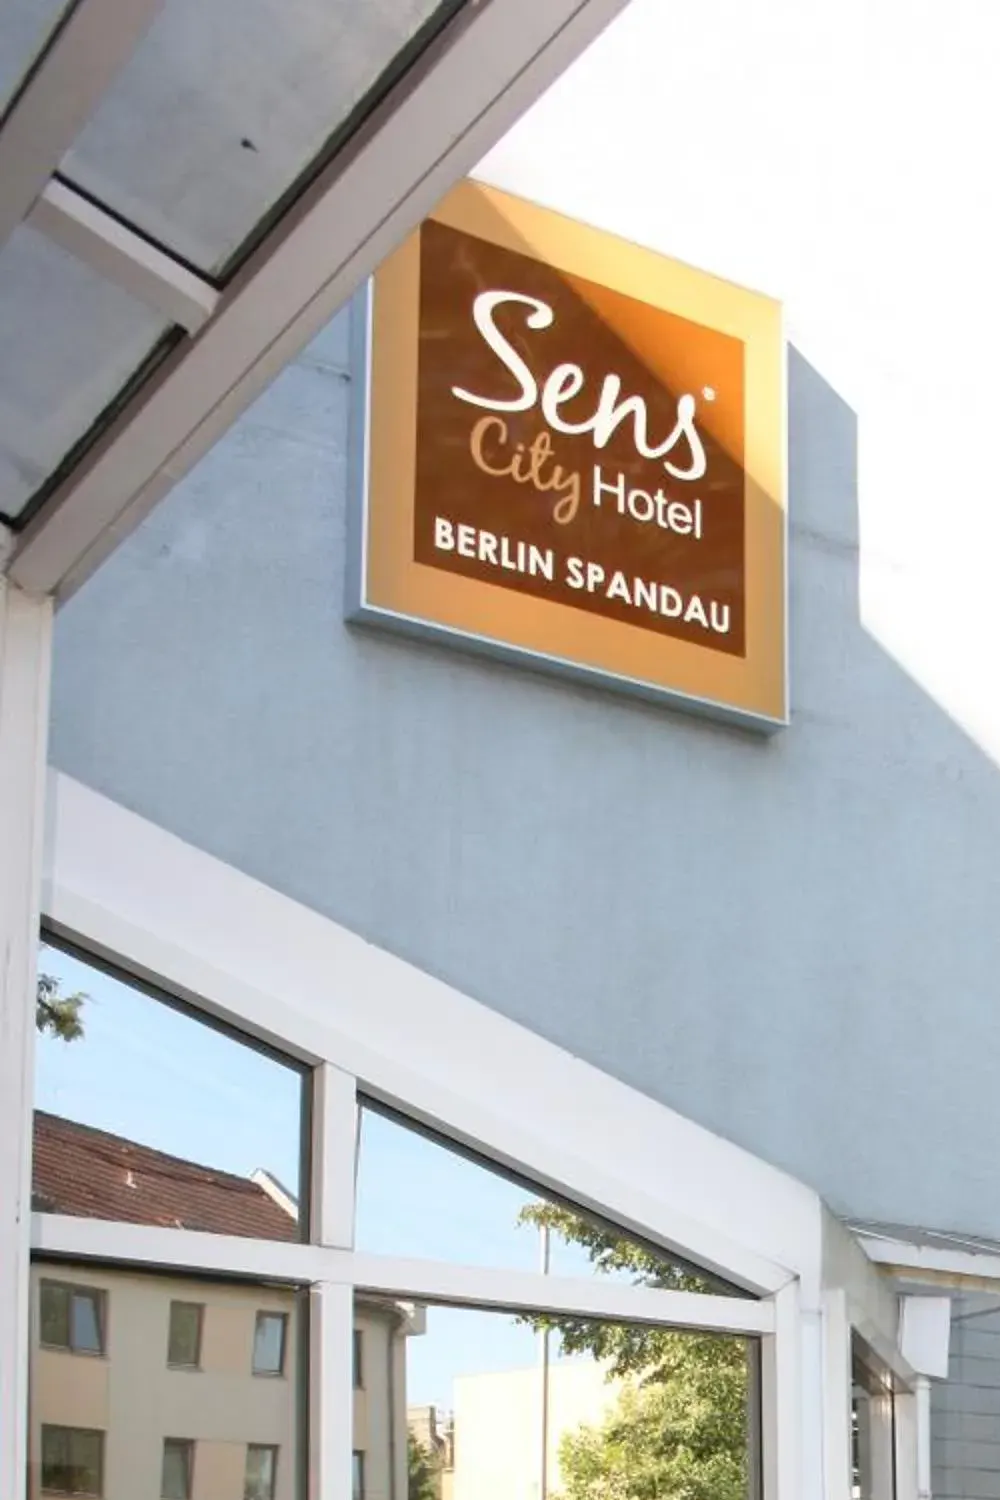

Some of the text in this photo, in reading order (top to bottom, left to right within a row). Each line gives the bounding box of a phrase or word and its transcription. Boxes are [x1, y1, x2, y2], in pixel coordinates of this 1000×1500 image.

[451, 290, 707, 481] Sens
[470, 415, 703, 540] City Hotel
[434, 516, 730, 634] BERLIN SPANDAU
